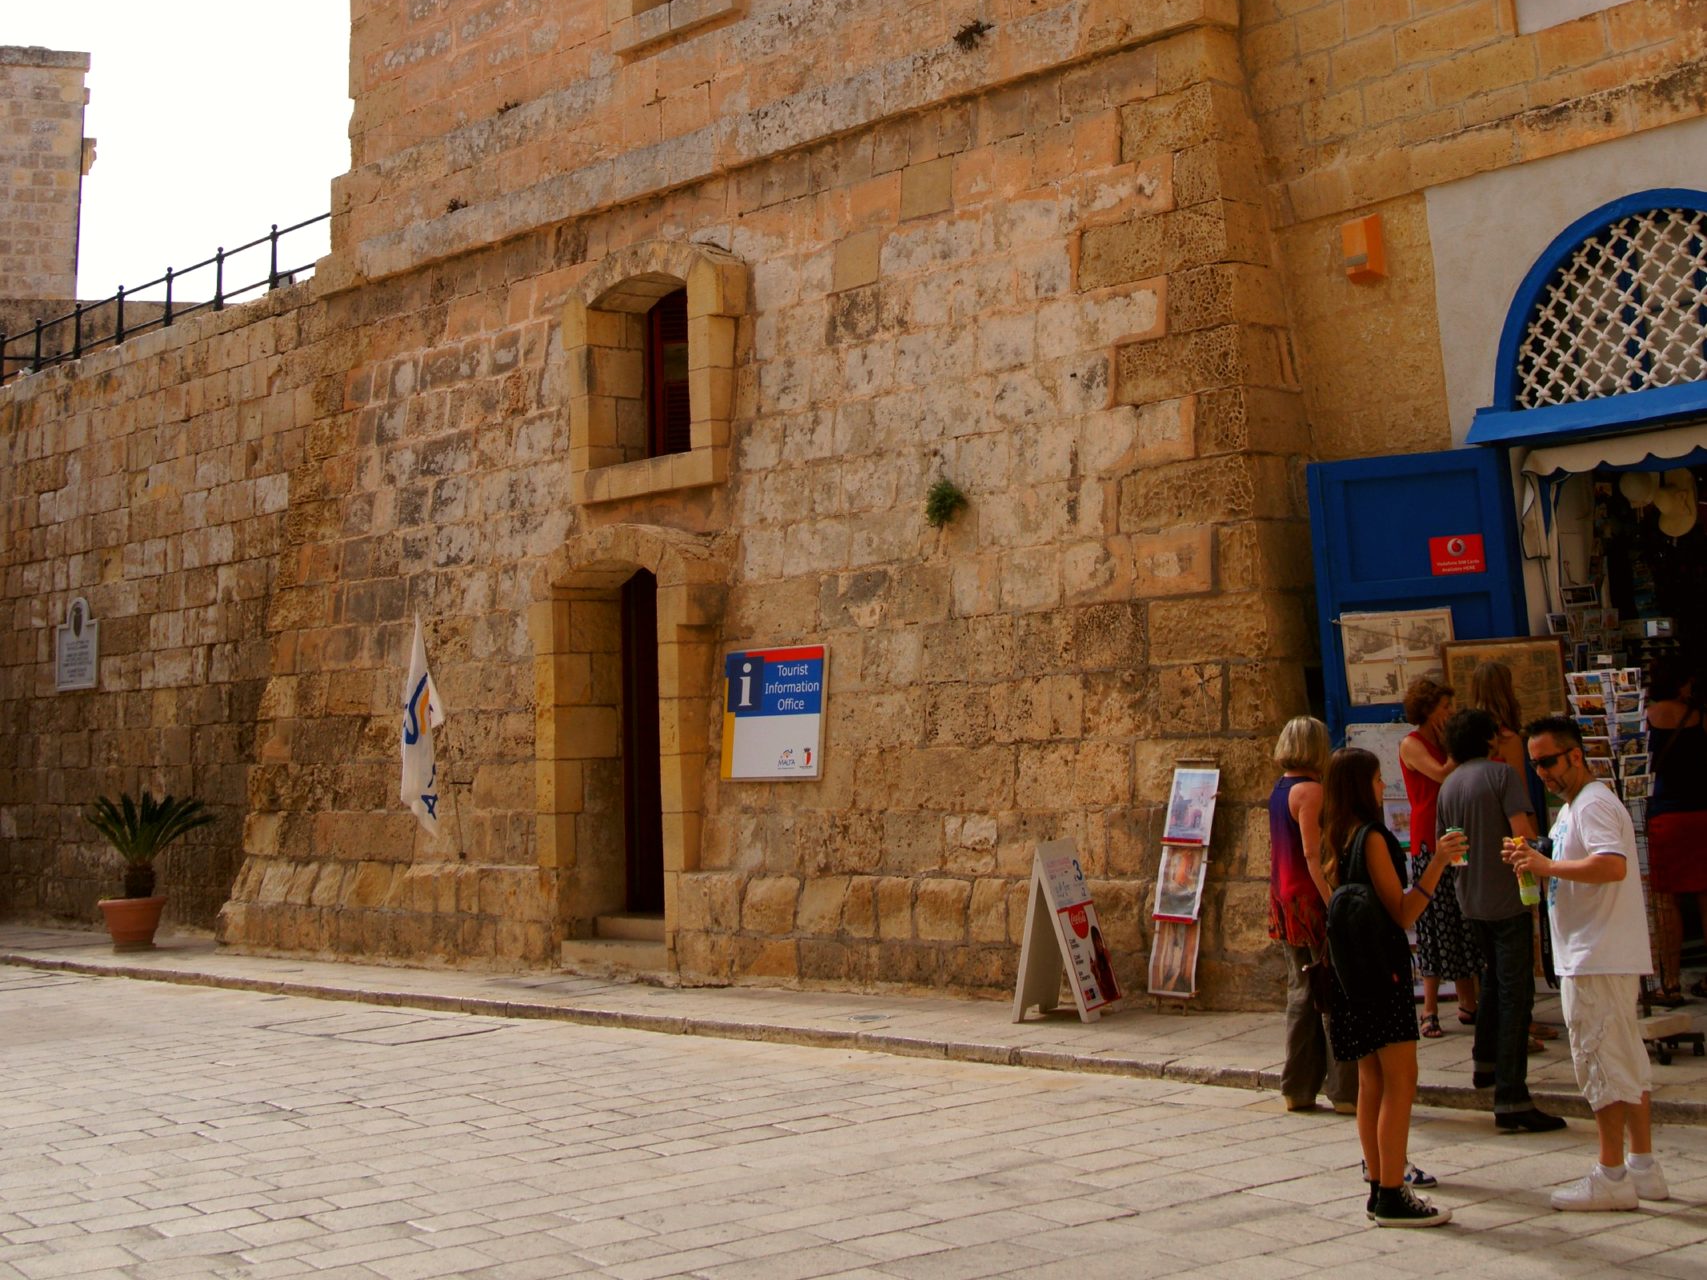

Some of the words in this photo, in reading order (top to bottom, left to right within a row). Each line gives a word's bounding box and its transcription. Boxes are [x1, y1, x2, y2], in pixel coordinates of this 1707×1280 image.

[777, 664, 808, 676] Tourist
[765, 681, 819, 694] Information
[777, 698, 804, 710] Office
[777, 759, 796, 767] MALTA
